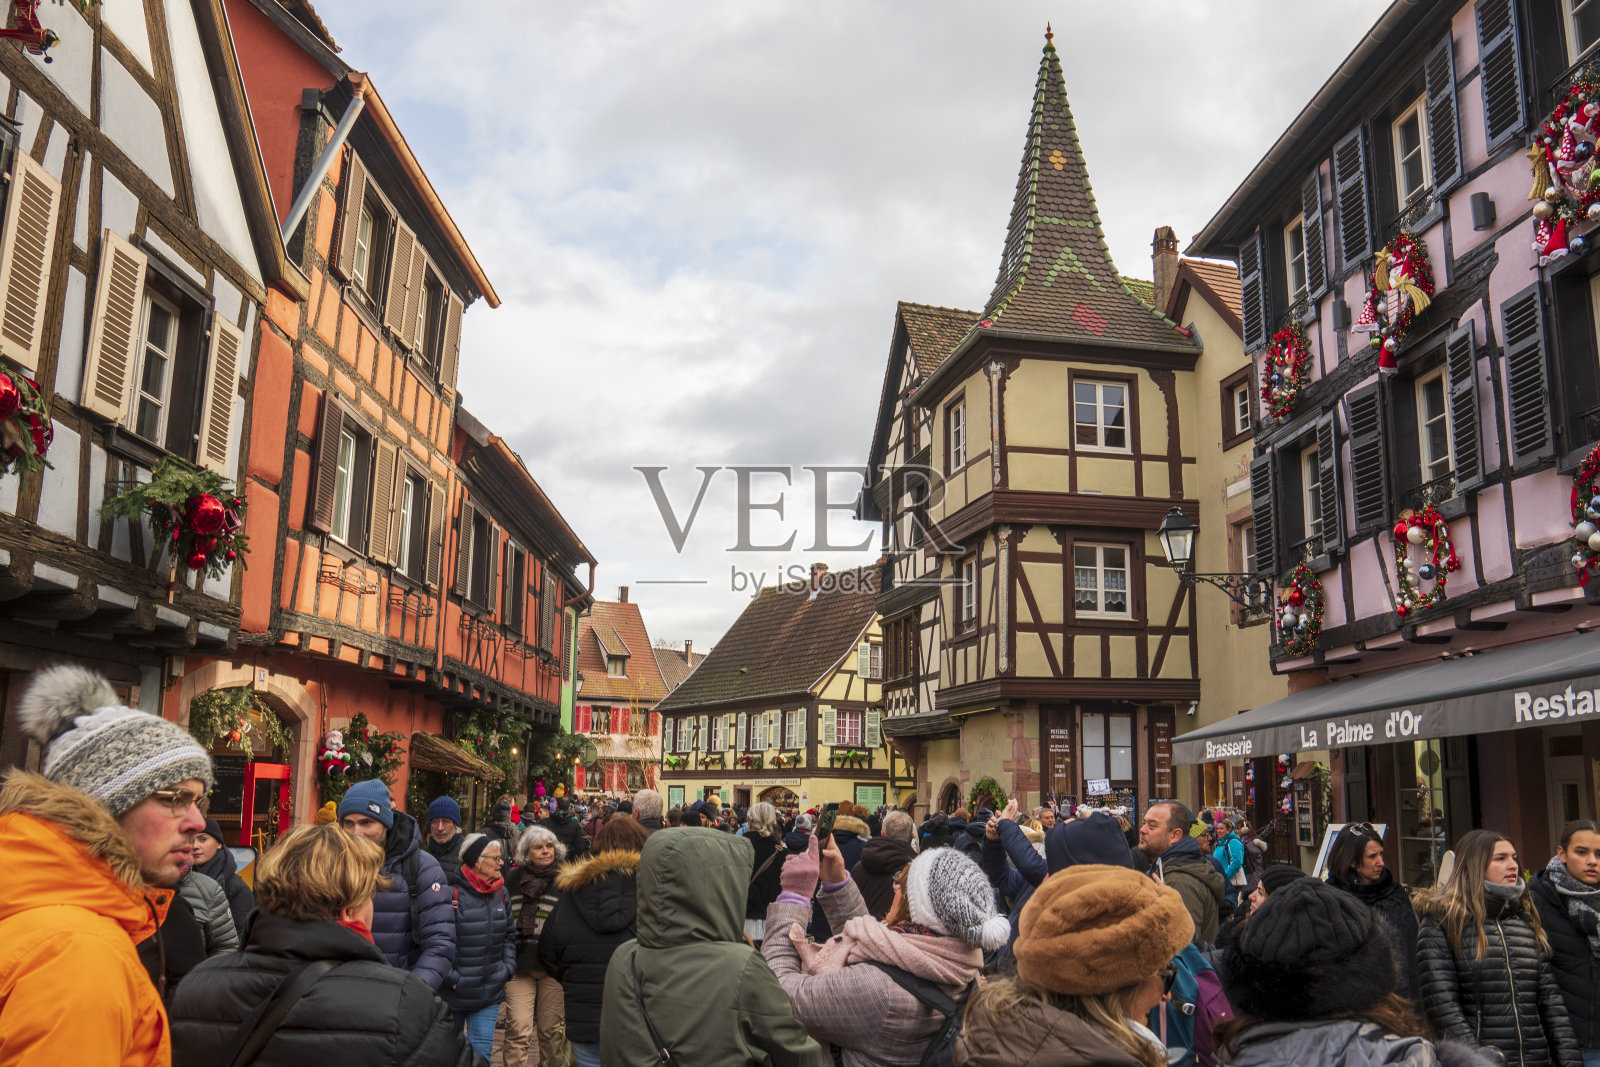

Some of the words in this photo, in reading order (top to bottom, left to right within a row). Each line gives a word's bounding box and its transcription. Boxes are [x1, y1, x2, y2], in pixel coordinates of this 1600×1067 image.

[1206, 736, 1253, 759] Brasserie
[1301, 726, 1318, 748] La
[1327, 720, 1374, 745] Palme
[1385, 709, 1422, 738] d'Or
